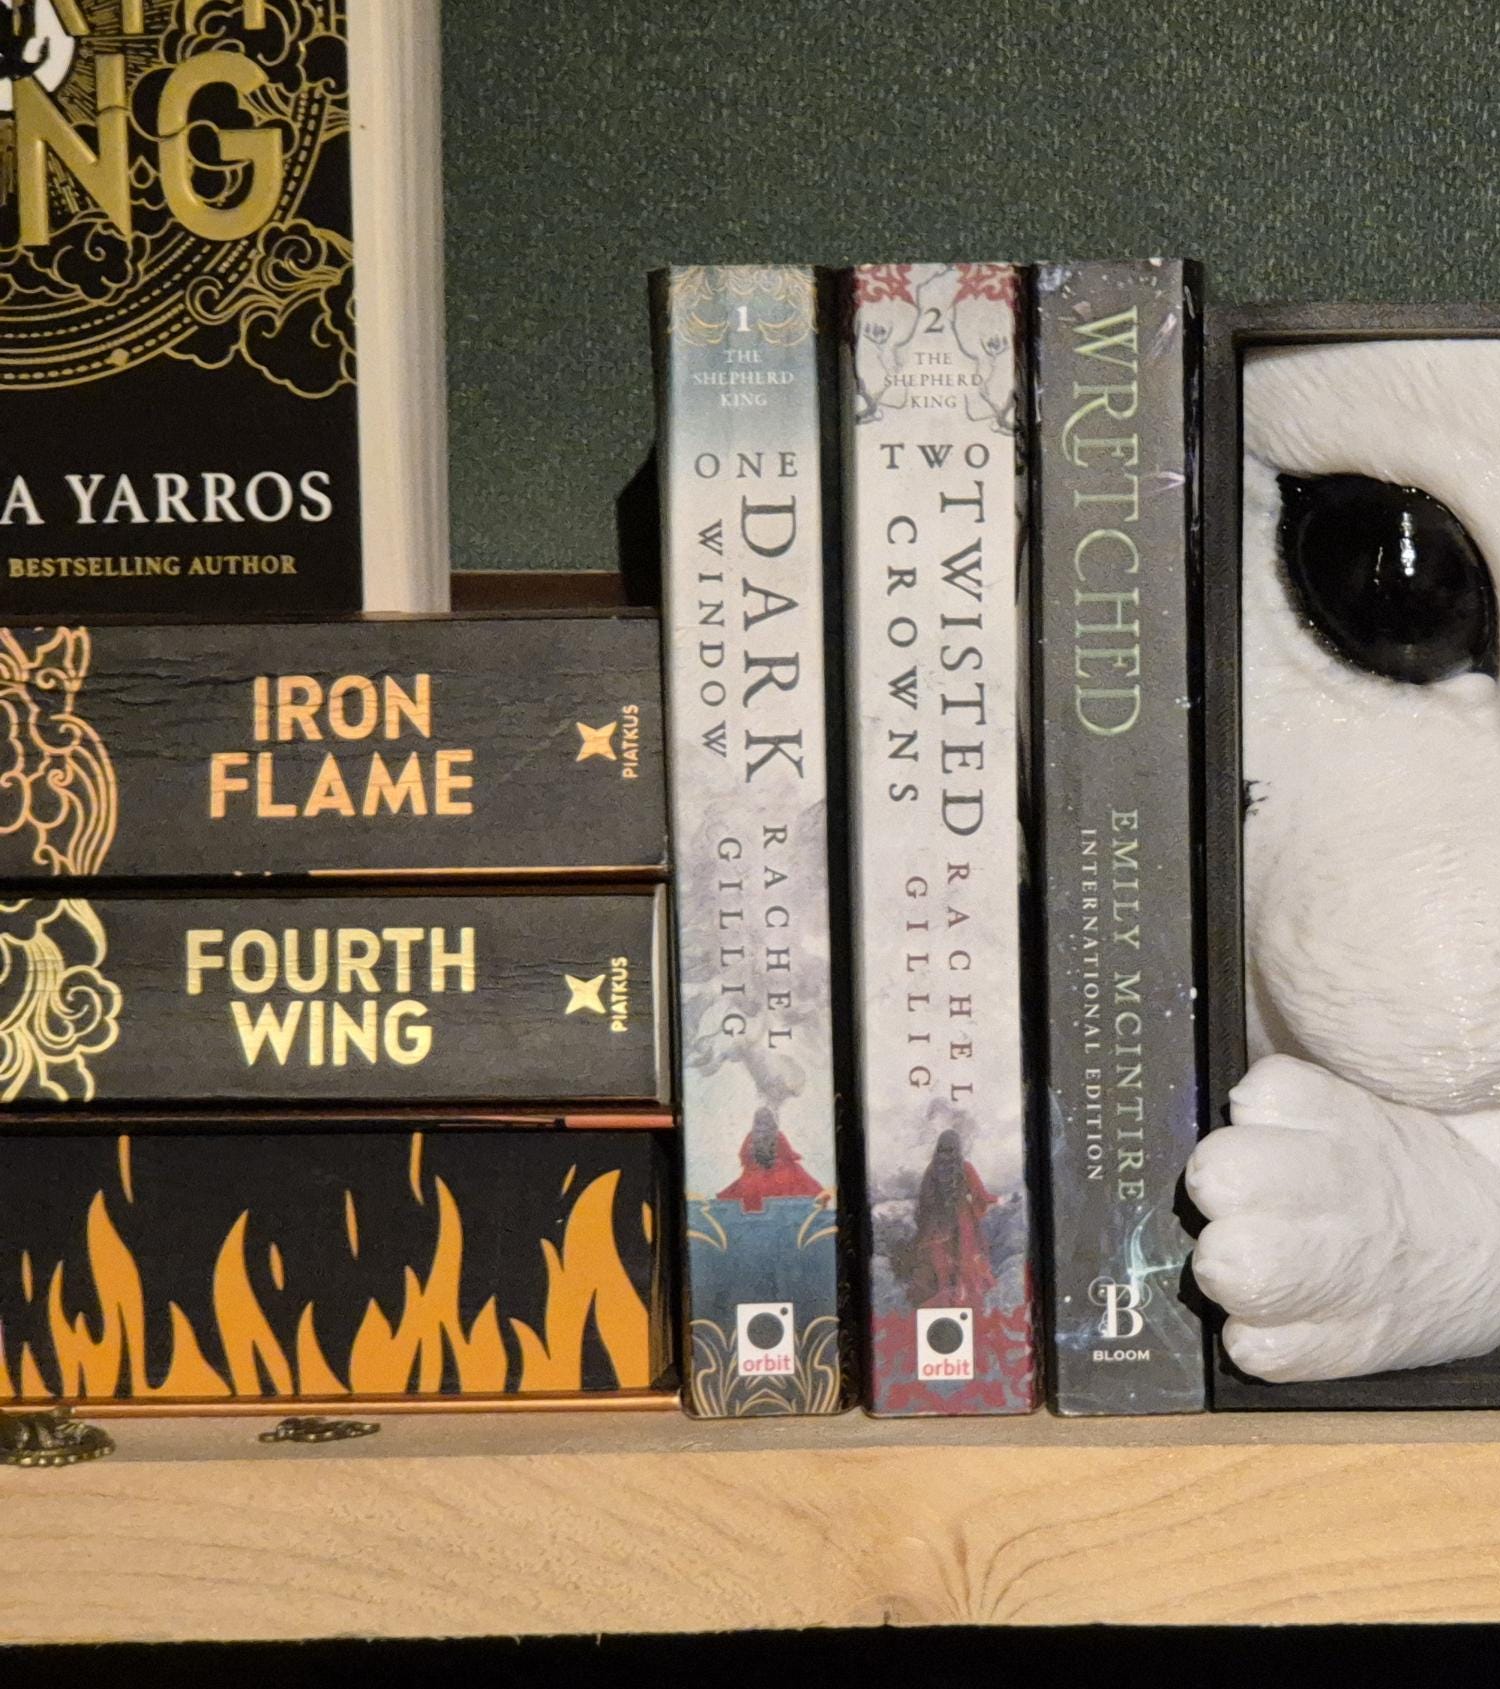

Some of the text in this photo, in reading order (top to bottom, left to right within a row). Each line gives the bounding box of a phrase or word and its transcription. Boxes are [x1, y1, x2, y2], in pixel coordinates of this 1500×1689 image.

[736, 305, 749, 332] 1
[924, 307, 945, 334] 2
[692, 370, 795, 385] SHEPHERD
[723, 349, 762, 364] THE
[884, 372, 984, 387] SHEPHERD
[914, 351, 952, 366] THE
[720, 392, 767, 407] KING
[910, 394, 958, 410] KING
[694, 452, 798, 478] ONE
[880, 443, 990, 470] TWO
[0, 471, 333, 525] A YARROS
[1061, 306, 1141, 736] WRETCHED
[9, 554, 297, 578] BESTSELLING AUTHOR
[697, 519, 727, 757] WINDOW
[741, 495, 804, 783] DARK
[886, 515, 919, 802] CROWNS
[939, 480, 985, 837] TWISTED
[251, 672, 432, 740] IRON
[623, 703, 639, 778] PIATKUS
[209, 749, 475, 818] FLAME
[185, 926, 477, 995] FOURTH
[717, 837, 746, 1038] GILLIG
[763, 825, 792, 1049] RACHEL
[610, 956, 628, 1032] PIATKUS
[905, 876, 931, 1089] GILLIG
[946, 861, 974, 1102] RACHEL
[1081, 829, 1104, 1181] INTERNATIONAL EDITION
[1111, 809, 1145, 1200] EMILY MCINTIRE
[230, 1001, 432, 1067] WING
[742, 1355, 791, 1372] orbit
[922, 1359, 972, 1378] orbit
[1092, 1349, 1150, 1362] BLOOM
